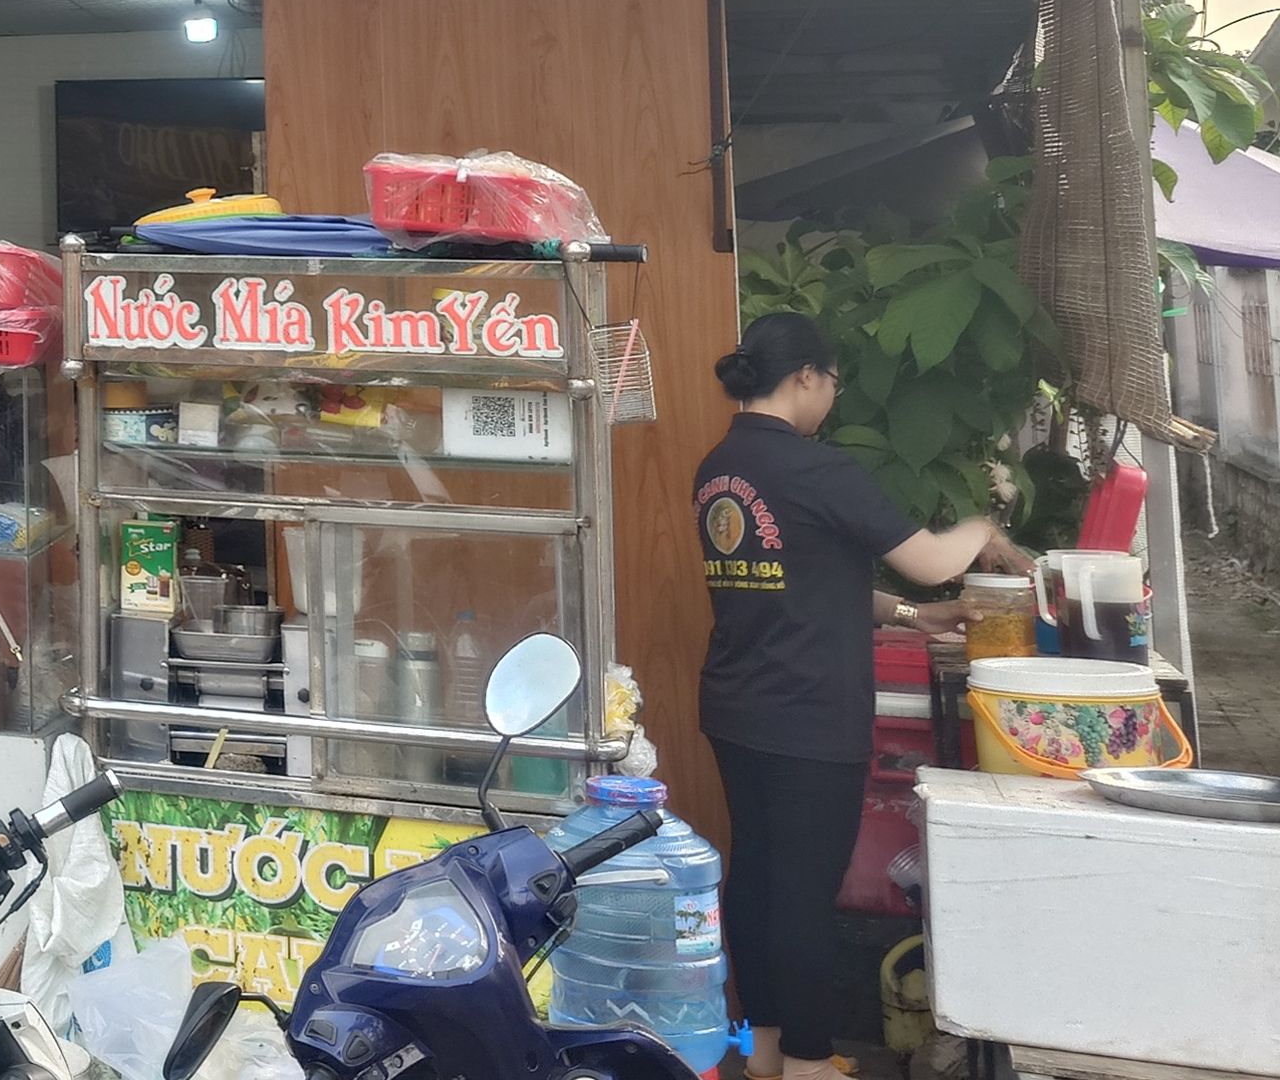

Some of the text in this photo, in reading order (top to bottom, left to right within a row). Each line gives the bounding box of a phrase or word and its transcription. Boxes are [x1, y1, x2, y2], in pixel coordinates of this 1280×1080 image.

[86, 274, 564, 357] Nước Mía Kim Yến
[750, 498, 783, 549] NGỌC
[112, 818, 370, 913] NƯỚC
